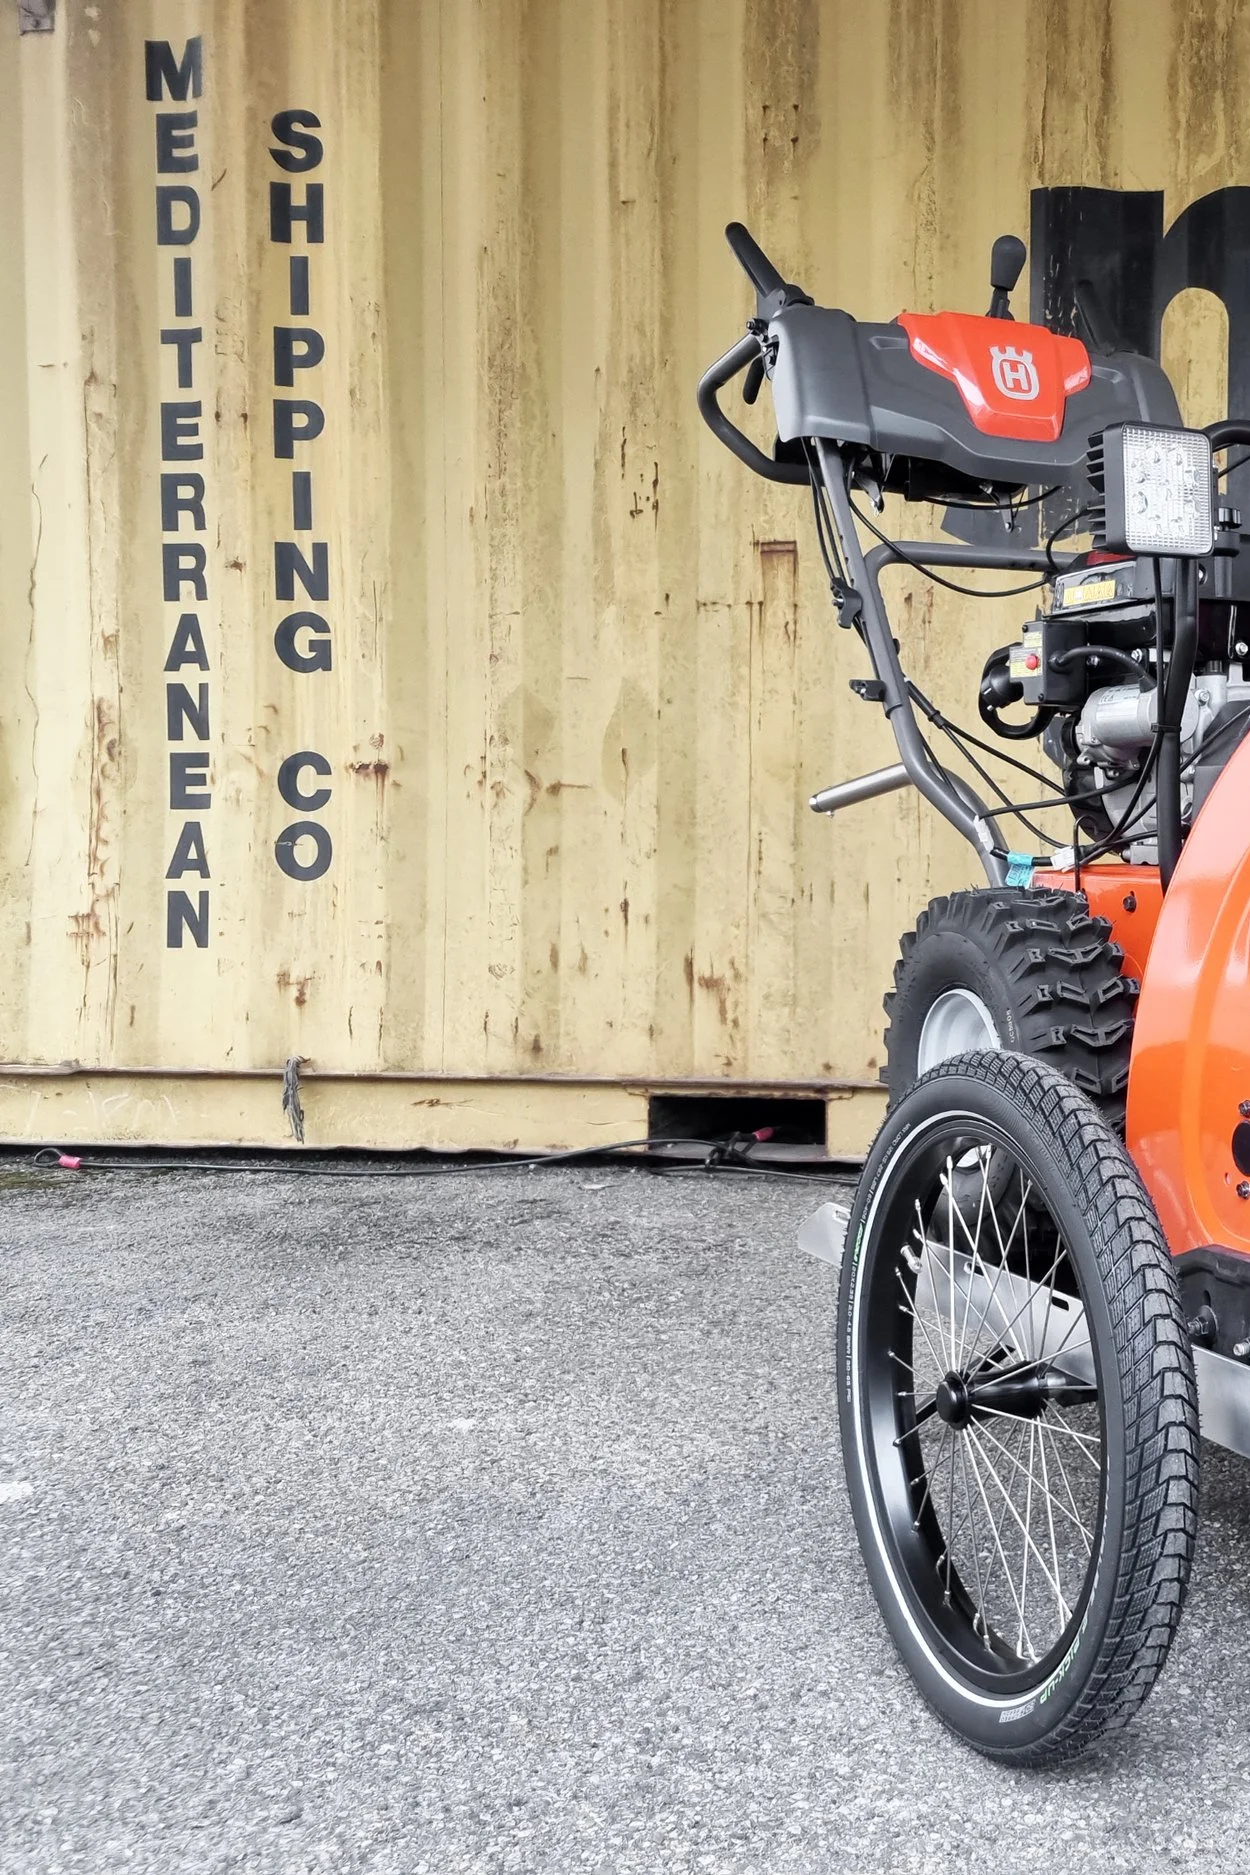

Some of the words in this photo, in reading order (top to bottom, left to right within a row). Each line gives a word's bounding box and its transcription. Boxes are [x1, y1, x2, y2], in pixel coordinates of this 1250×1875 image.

[144, 35, 211, 950] MEDITERRANEAN
[268, 109, 333, 674] SHIPPING
[276, 751, 333, 882] CO
